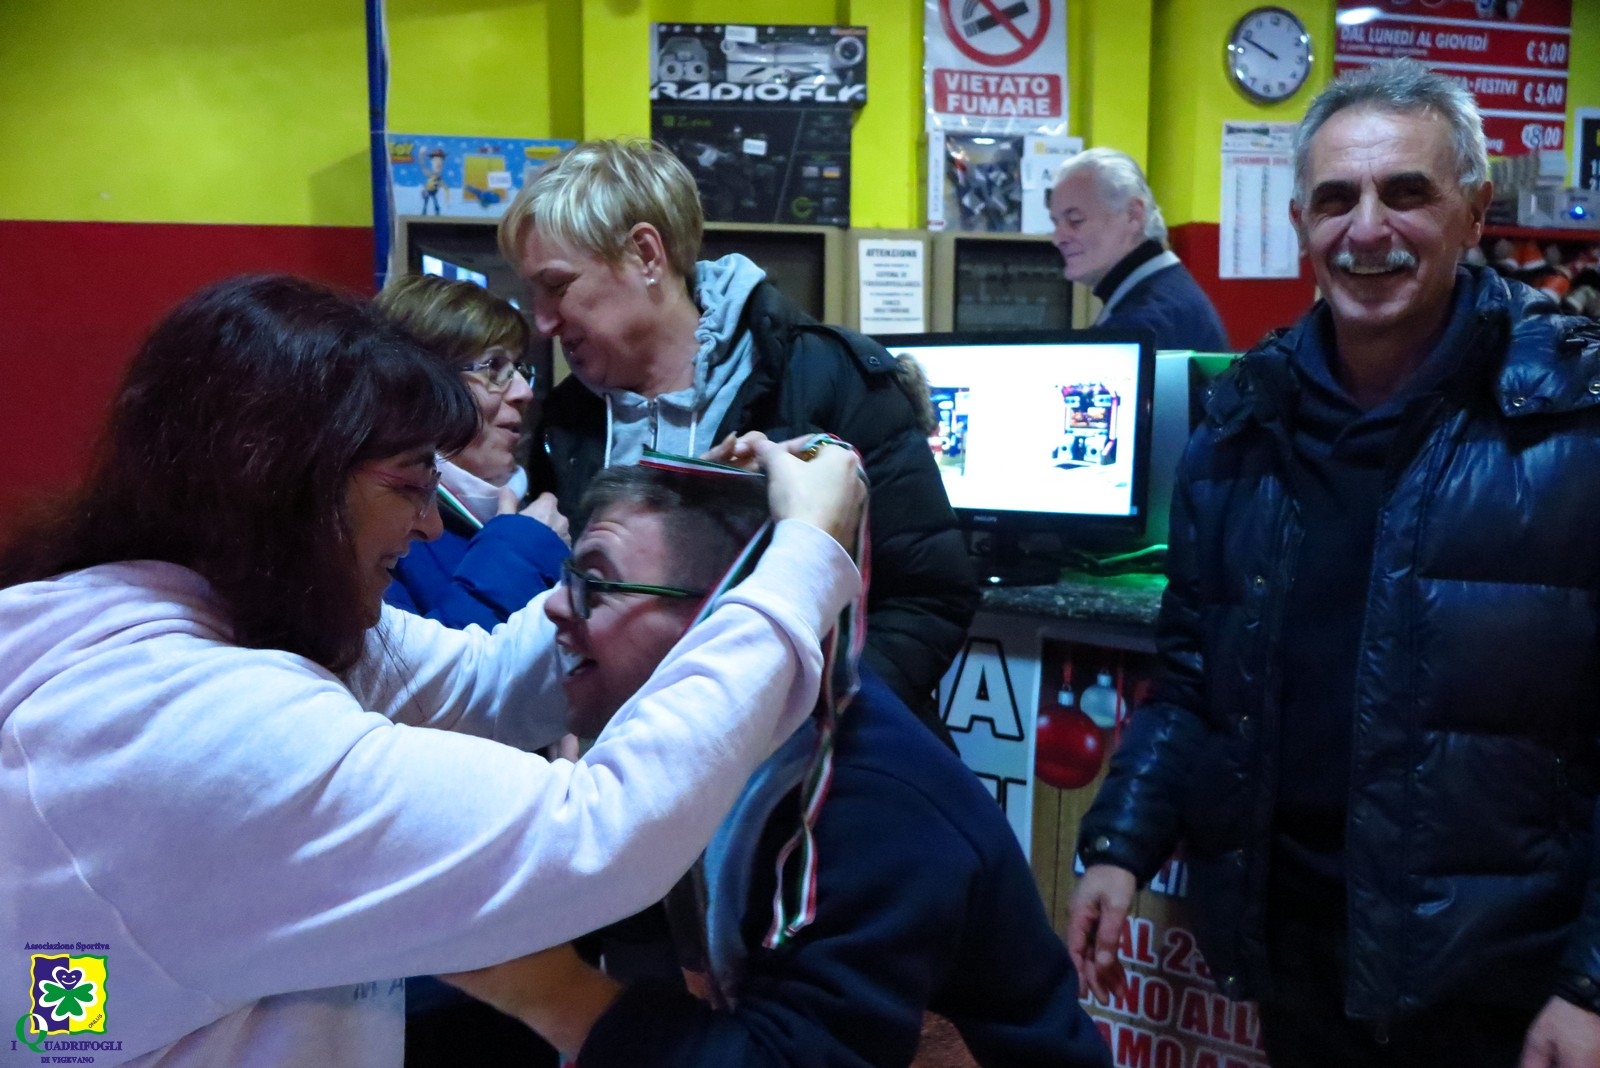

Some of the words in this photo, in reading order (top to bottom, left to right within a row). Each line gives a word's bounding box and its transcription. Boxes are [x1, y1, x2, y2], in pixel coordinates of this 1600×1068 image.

[1416, 30, 1433, 47] AL
[1435, 32, 1489, 51] GIOVEDÌ
[944, 72, 1050, 94] VIETATO
[946, 94, 1051, 116] FUMARE
